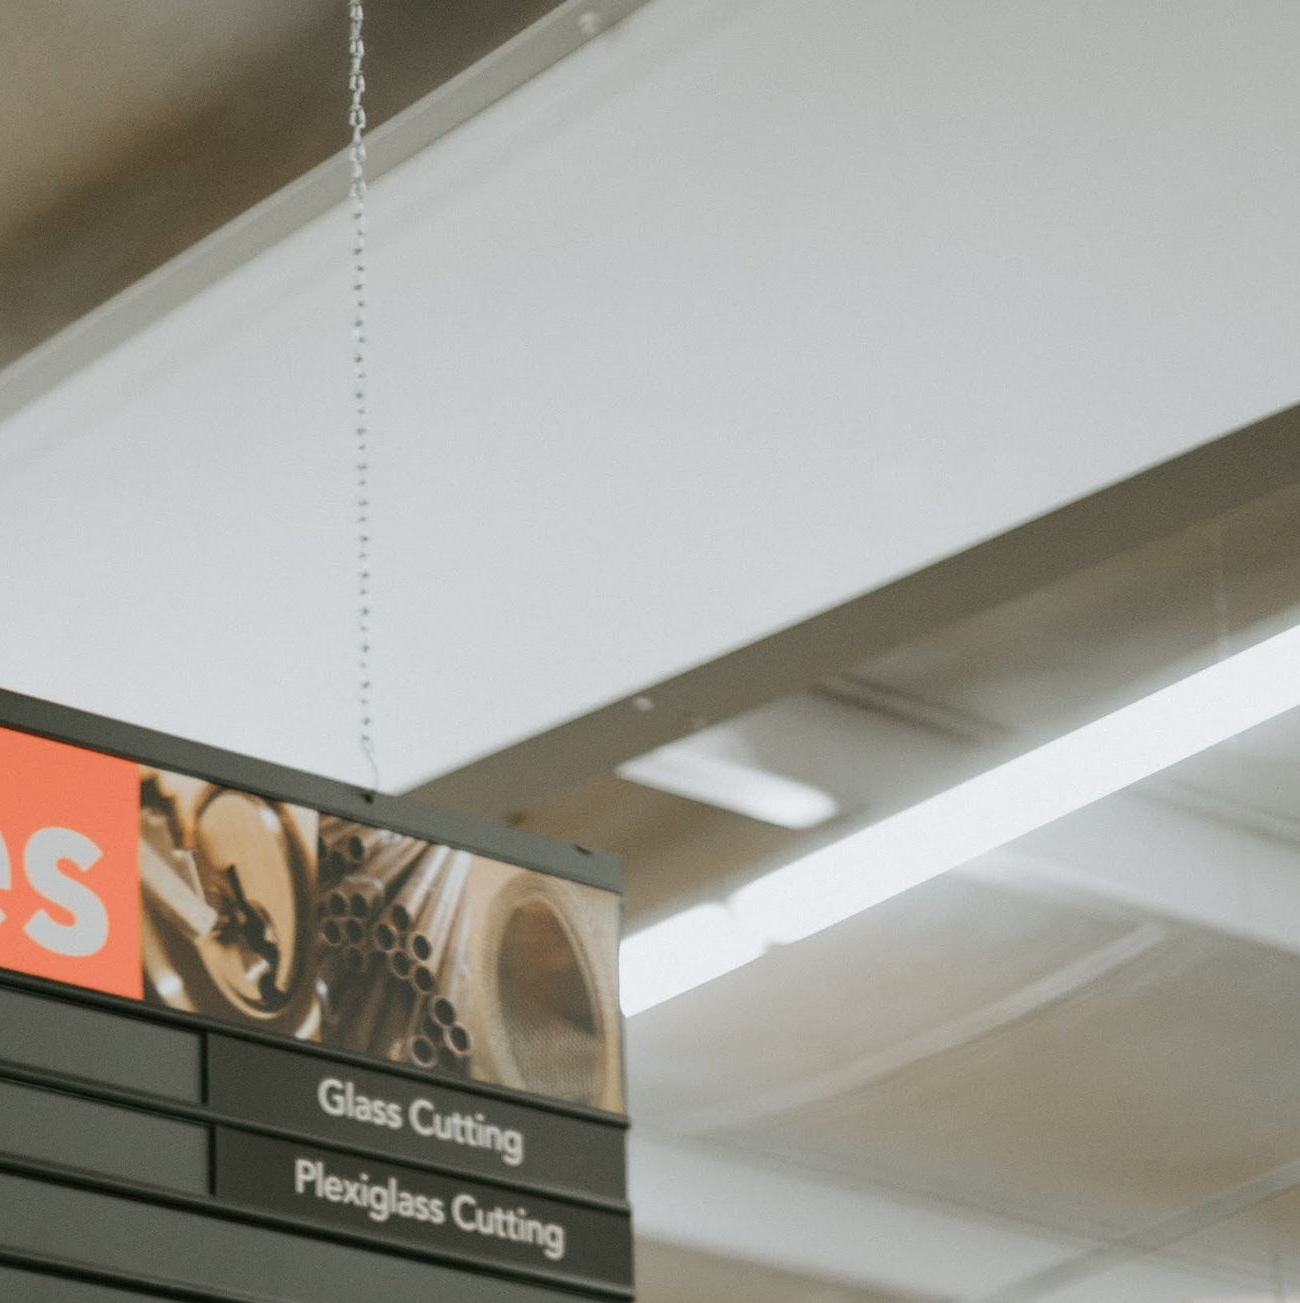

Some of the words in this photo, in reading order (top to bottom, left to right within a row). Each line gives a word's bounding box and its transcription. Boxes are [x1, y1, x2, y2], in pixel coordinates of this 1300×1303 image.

[317, 1079, 402, 1129] Glass
[409, 1099, 524, 1166] Cutting
[294, 1159, 445, 1224] Plexiglass
[451, 1194, 566, 1259] Cutting
